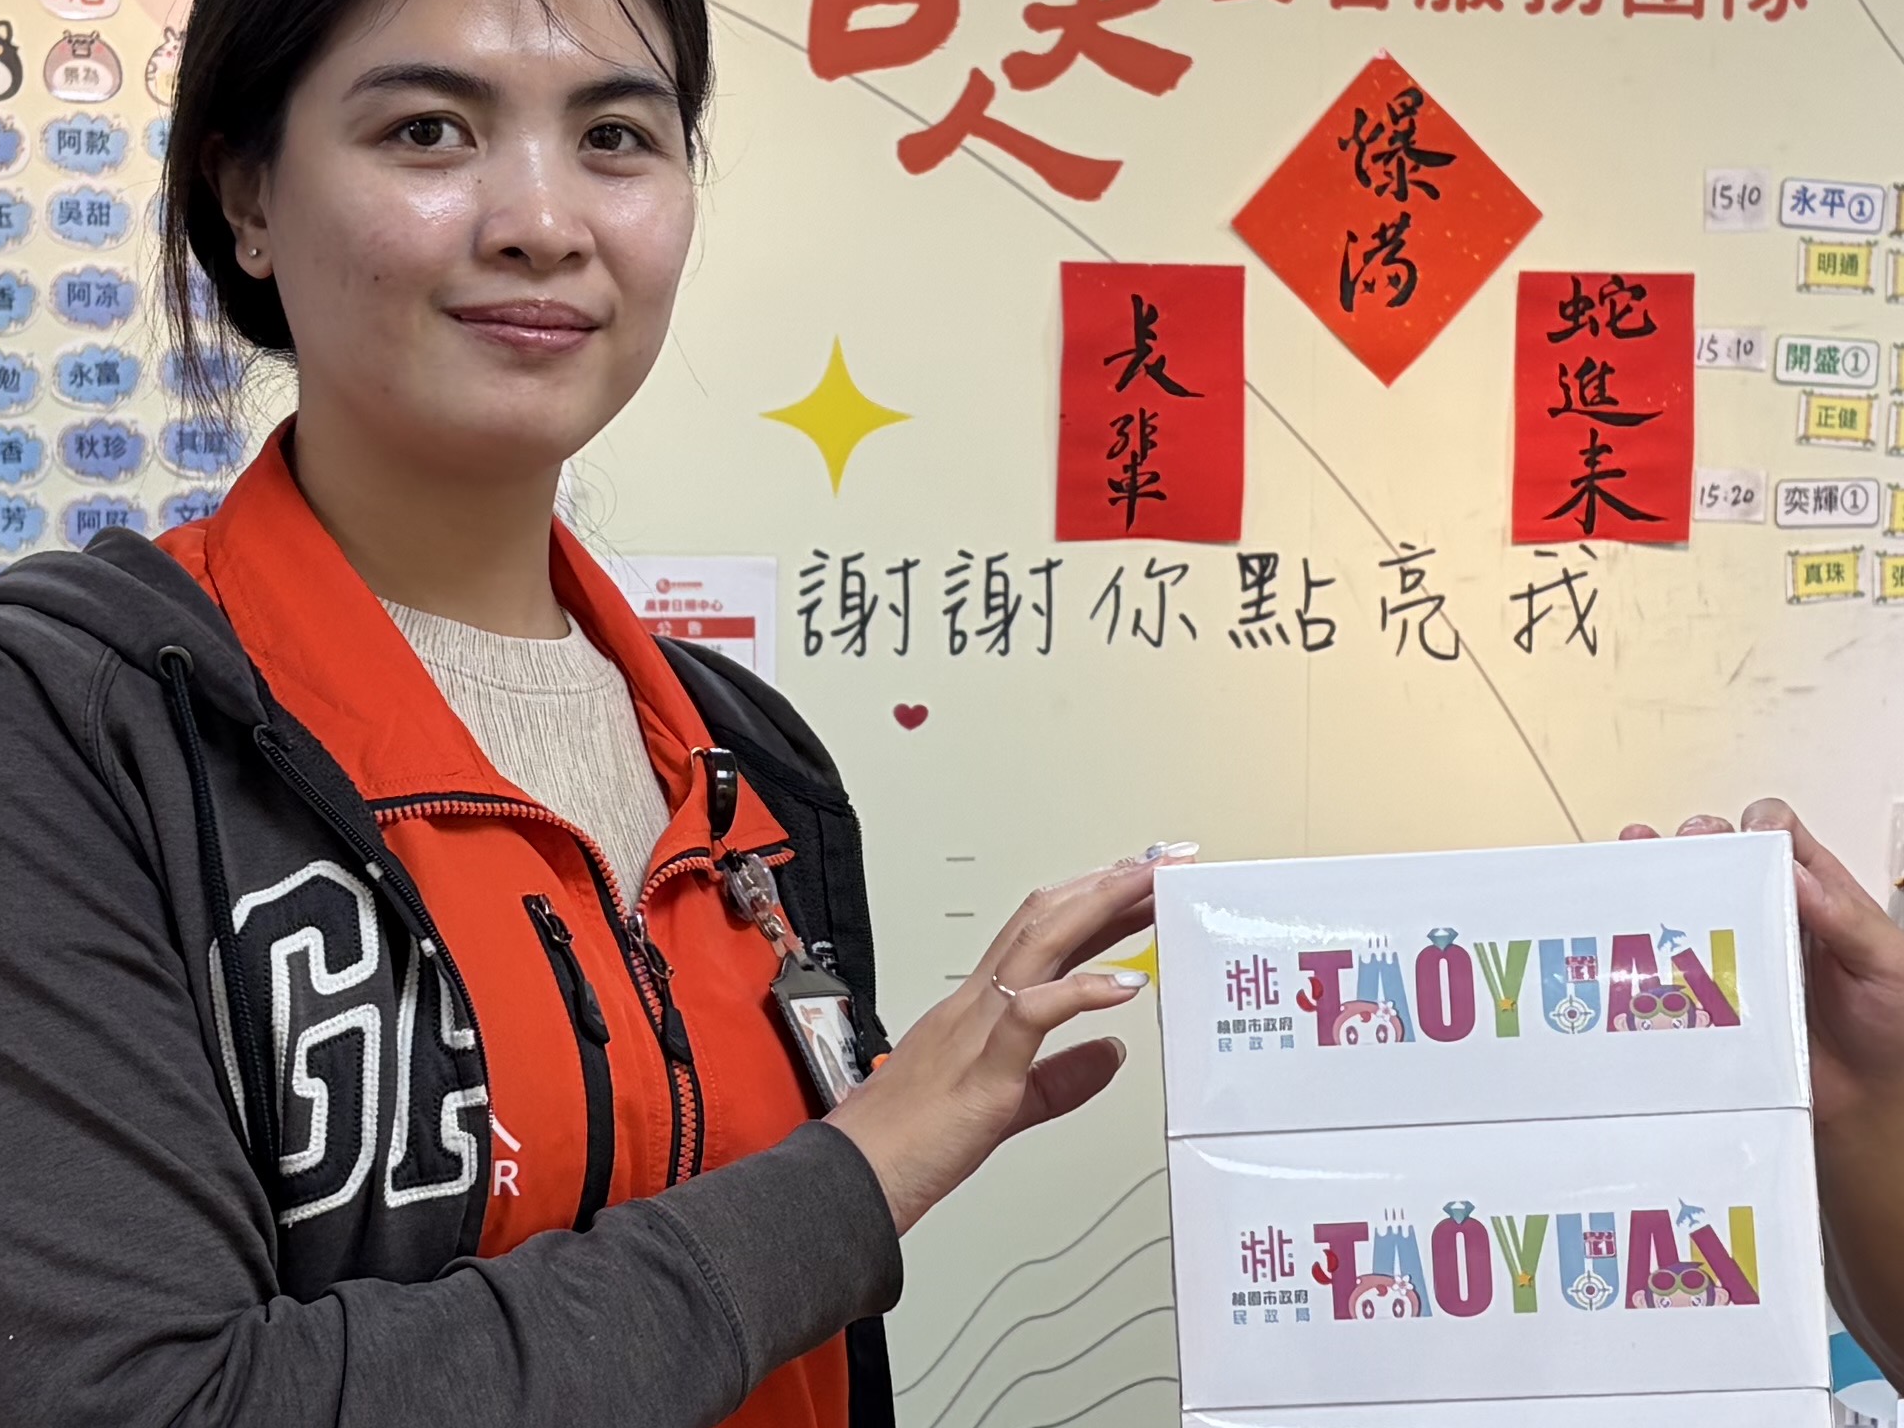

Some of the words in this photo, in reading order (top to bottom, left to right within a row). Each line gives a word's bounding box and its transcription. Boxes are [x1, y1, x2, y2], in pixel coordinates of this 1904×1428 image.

[58, 200, 111, 228] 吳甜
[1817, 252, 1859, 278] 明通
[68, 360, 121, 388] 永富
[1816, 405, 1859, 431] 正健
[75, 435, 128, 461] 秋珍
[794, 543, 1602, 659] 謝謝你點亮我
[1296, 928, 1742, 1047] TAOYUAN
[1216, 1017, 1294, 1037] 桃園市政府
[1217, 1037, 1296, 1054] 民政局
[1313, 1204, 1761, 1321] TAOYUAN
[1231, 1289, 1310, 1309] 桃園市政府
[1232, 1308, 1311, 1326] 民政局
